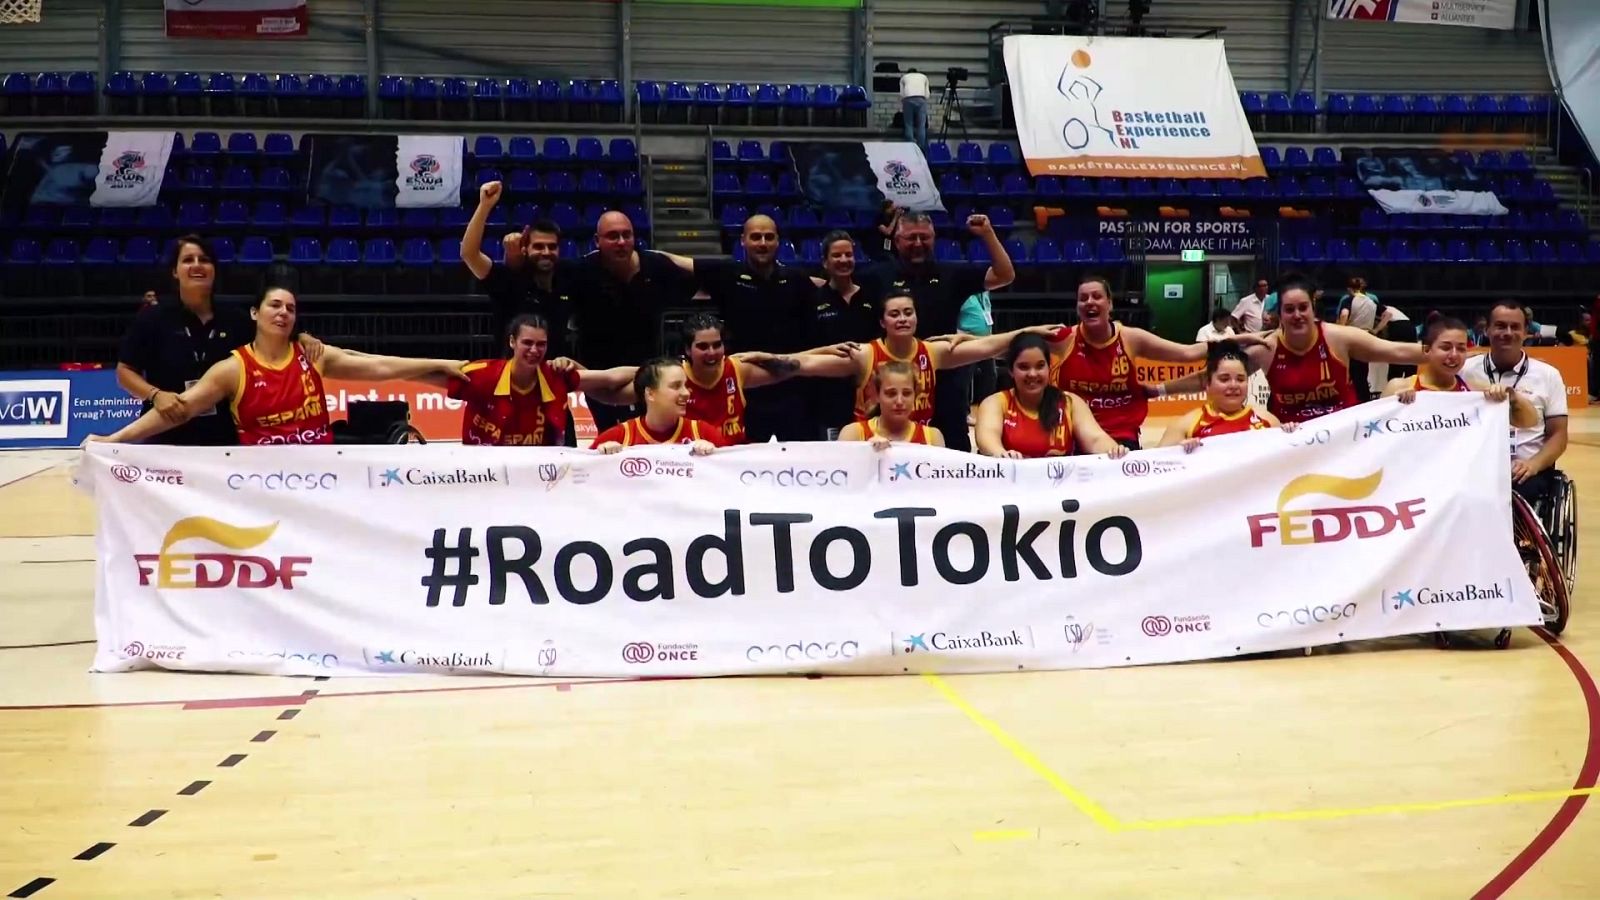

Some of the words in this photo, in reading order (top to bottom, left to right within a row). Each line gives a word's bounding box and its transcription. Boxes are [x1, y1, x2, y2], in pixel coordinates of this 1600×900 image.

[1112, 110, 1206, 124] Basketball
[1116, 124, 1211, 138] Experience
[1120, 137, 1140, 149] NL
[1047, 160, 1248, 172] BASKETBALLEXPERIENCE.NL
[1164, 222, 1191, 234] FOR
[1195, 221, 1250, 234] SPORTS.
[1179, 238, 1215, 250] MAKE
[1218, 238, 1227, 250] IT
[1320, 360, 1331, 381] 11
[74, 398, 91, 407] Een
[73, 410, 104, 421] vraag?
[107, 409, 133, 419] TvdW
[1385, 411, 1472, 434] CaixaBank
[227, 466, 338, 491] endesa
[406, 466, 498, 486] CaixaBank
[538, 463, 557, 482] CSD
[654, 467, 695, 479] ONCE
[739, 466, 849, 487] endesa
[914, 462, 1006, 480] CaixaBank
[145, 475, 184, 486] ONCE
[1246, 495, 1427, 548] FEDDF
[420, 498, 1144, 608] #RoadToTokio
[133, 548, 313, 592] FEDDF
[1416, 582, 1505, 605] CaixaBank
[1173, 614, 1211, 624] Fundación
[1256, 601, 1358, 628] endesa
[1063, 623, 1083, 644] CSD
[1173, 622, 1212, 633] ONCE
[657, 642, 699, 651] Fundación
[930, 629, 1024, 651] CaixaBank
[146, 650, 185, 661] ONCE
[400, 648, 494, 667] CaixaBank
[538, 649, 557, 666] CSD
[657, 650, 699, 661] ONCE
[746, 638, 859, 662] endesa
